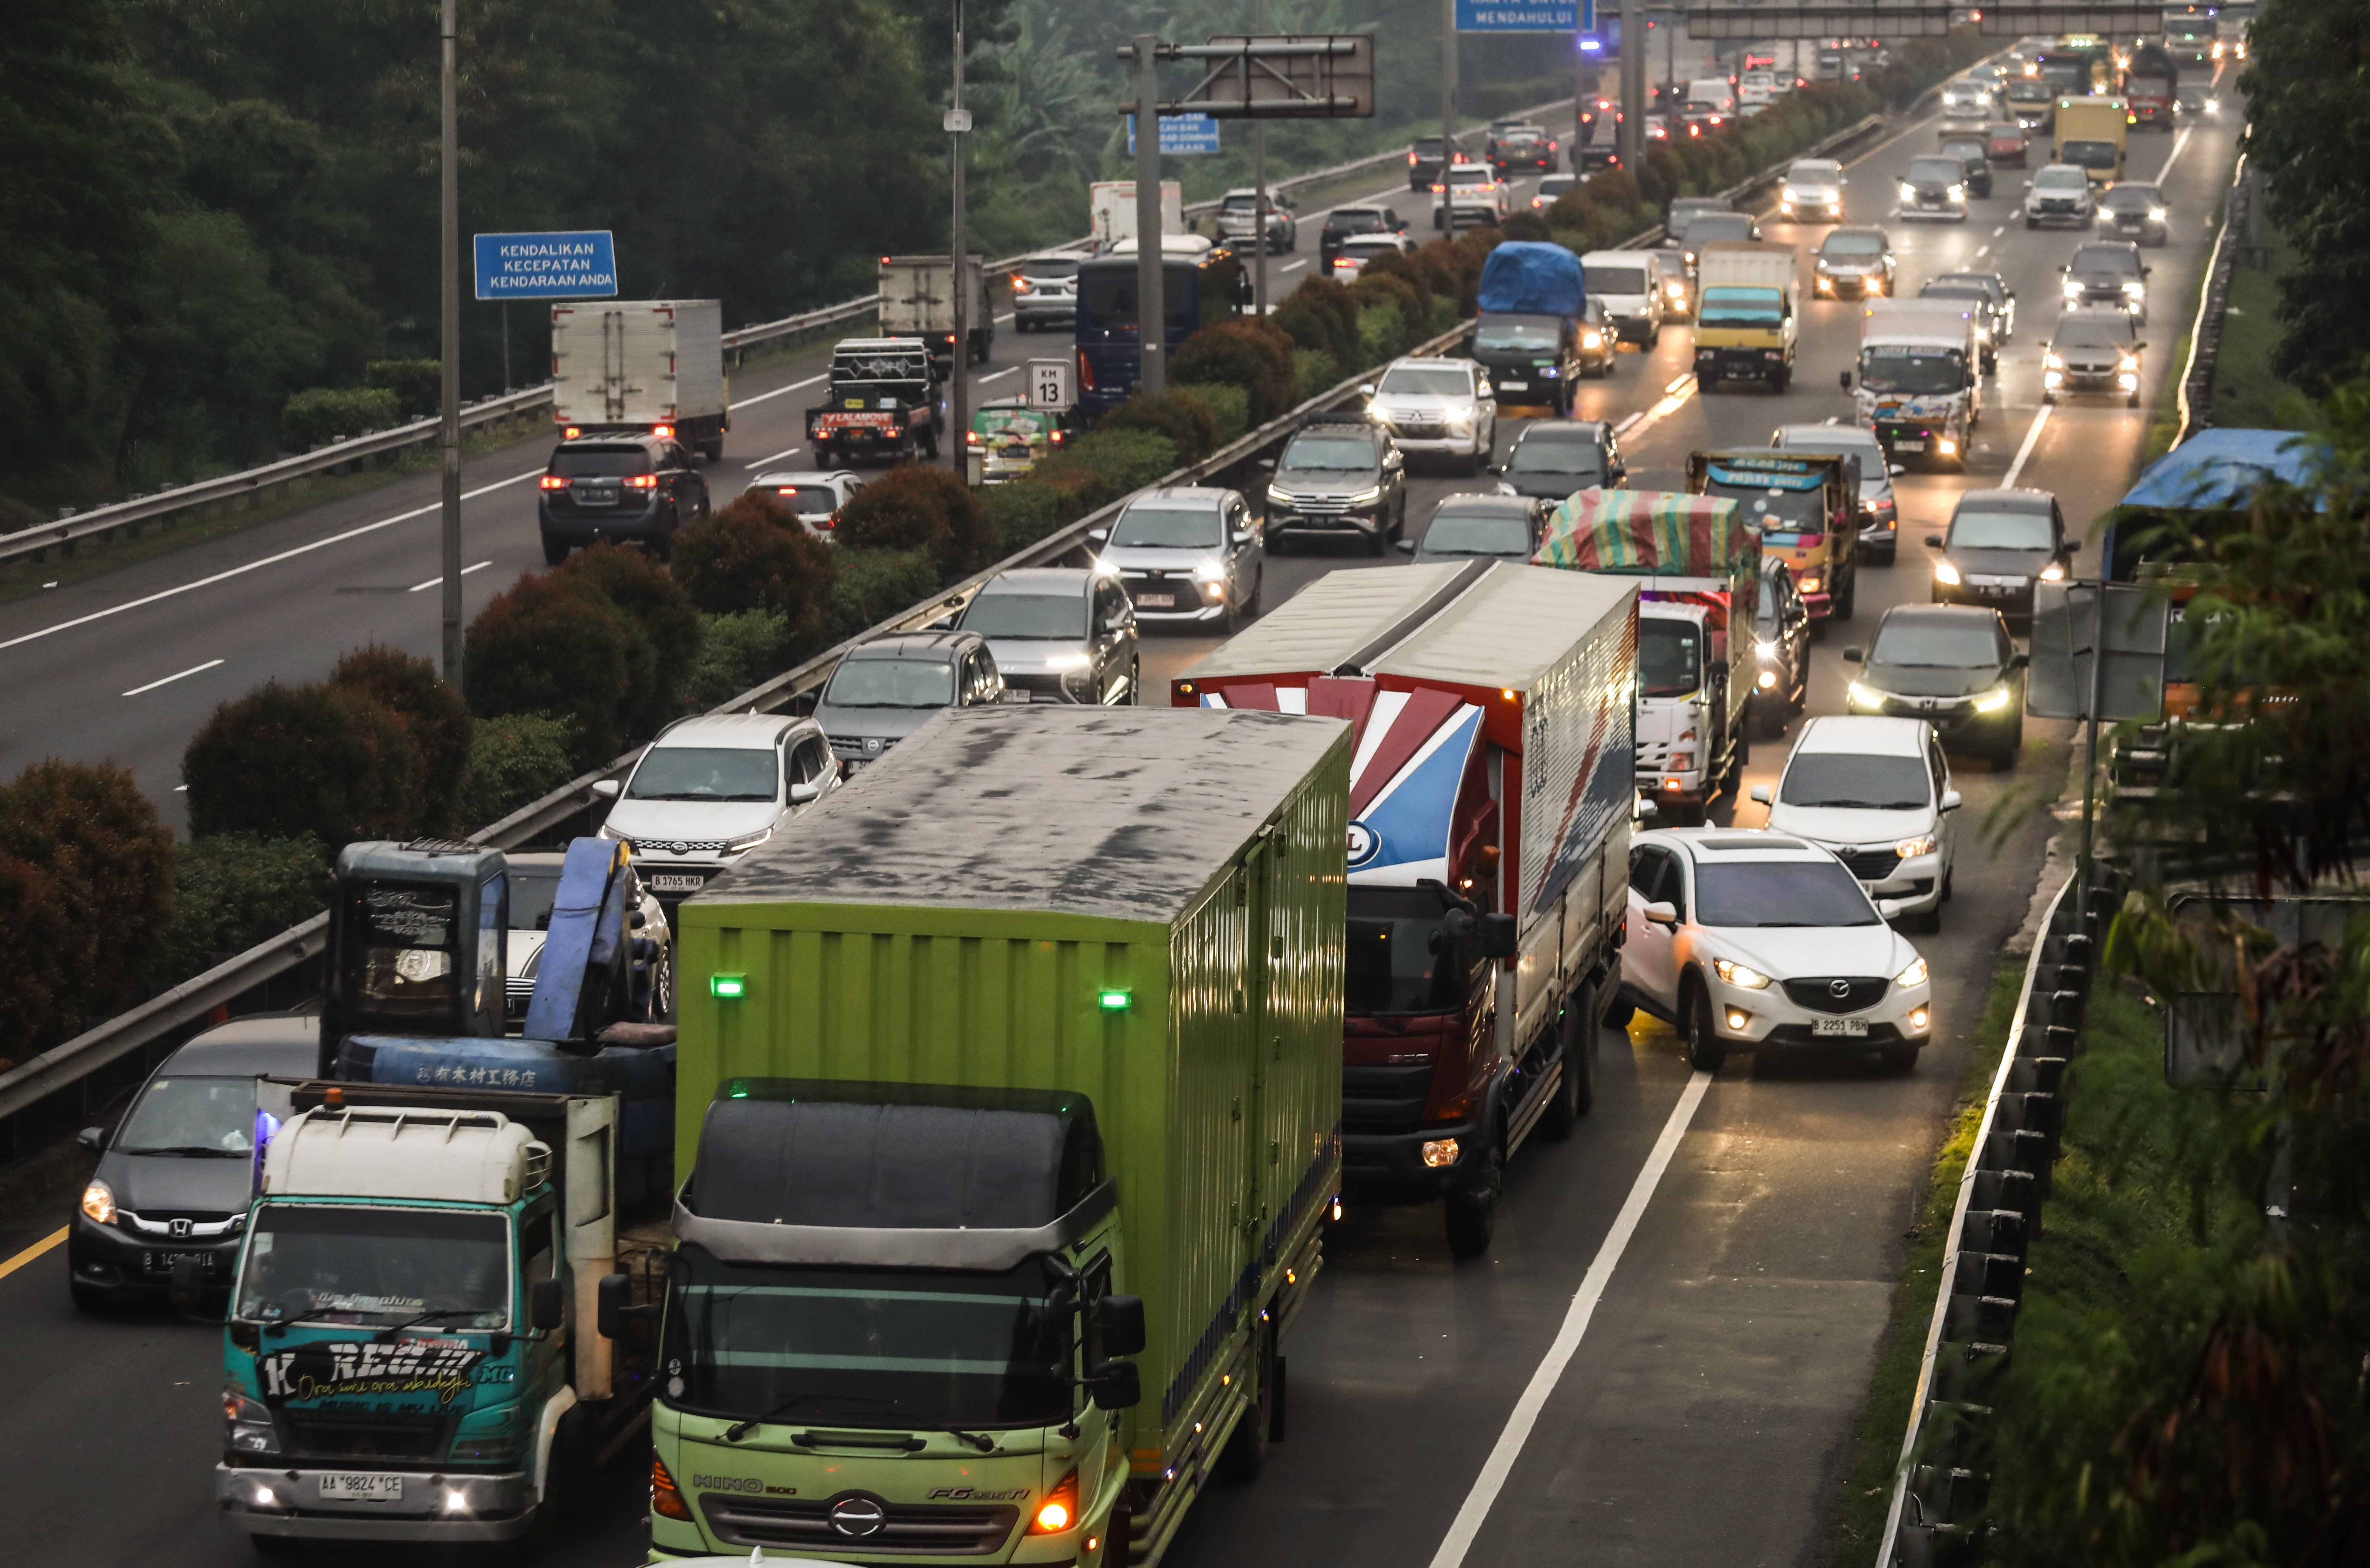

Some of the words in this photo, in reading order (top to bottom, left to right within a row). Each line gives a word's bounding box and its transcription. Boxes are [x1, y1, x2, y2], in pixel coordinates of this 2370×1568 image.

[1476, 11, 1571, 24] MENDAHULUI
[501, 243, 594, 257] KENDALIKAN
[504, 259, 590, 272] KECEPATAN
[490, 275, 576, 288] KENDARAAN
[579, 273, 612, 286] ANDA
[1041, 370, 1057, 378] KM
[1039, 382, 1058, 402] 13
[836, 413, 890, 422] LALAMOVE
[655, 876, 660, 885] B
[662, 876, 683, 885] 1765
[686, 877, 701, 886] HKR
[1813, 1019, 1819, 1030] B
[1824, 1020, 1845, 1031] 2251
[146, 1253, 152, 1265] B
[322, 1475, 336, 1490] AA
[345, 1476, 375, 1490] 9824
[385, 1476, 400, 1491] CE
[694, 1474, 763, 1493] HINO
